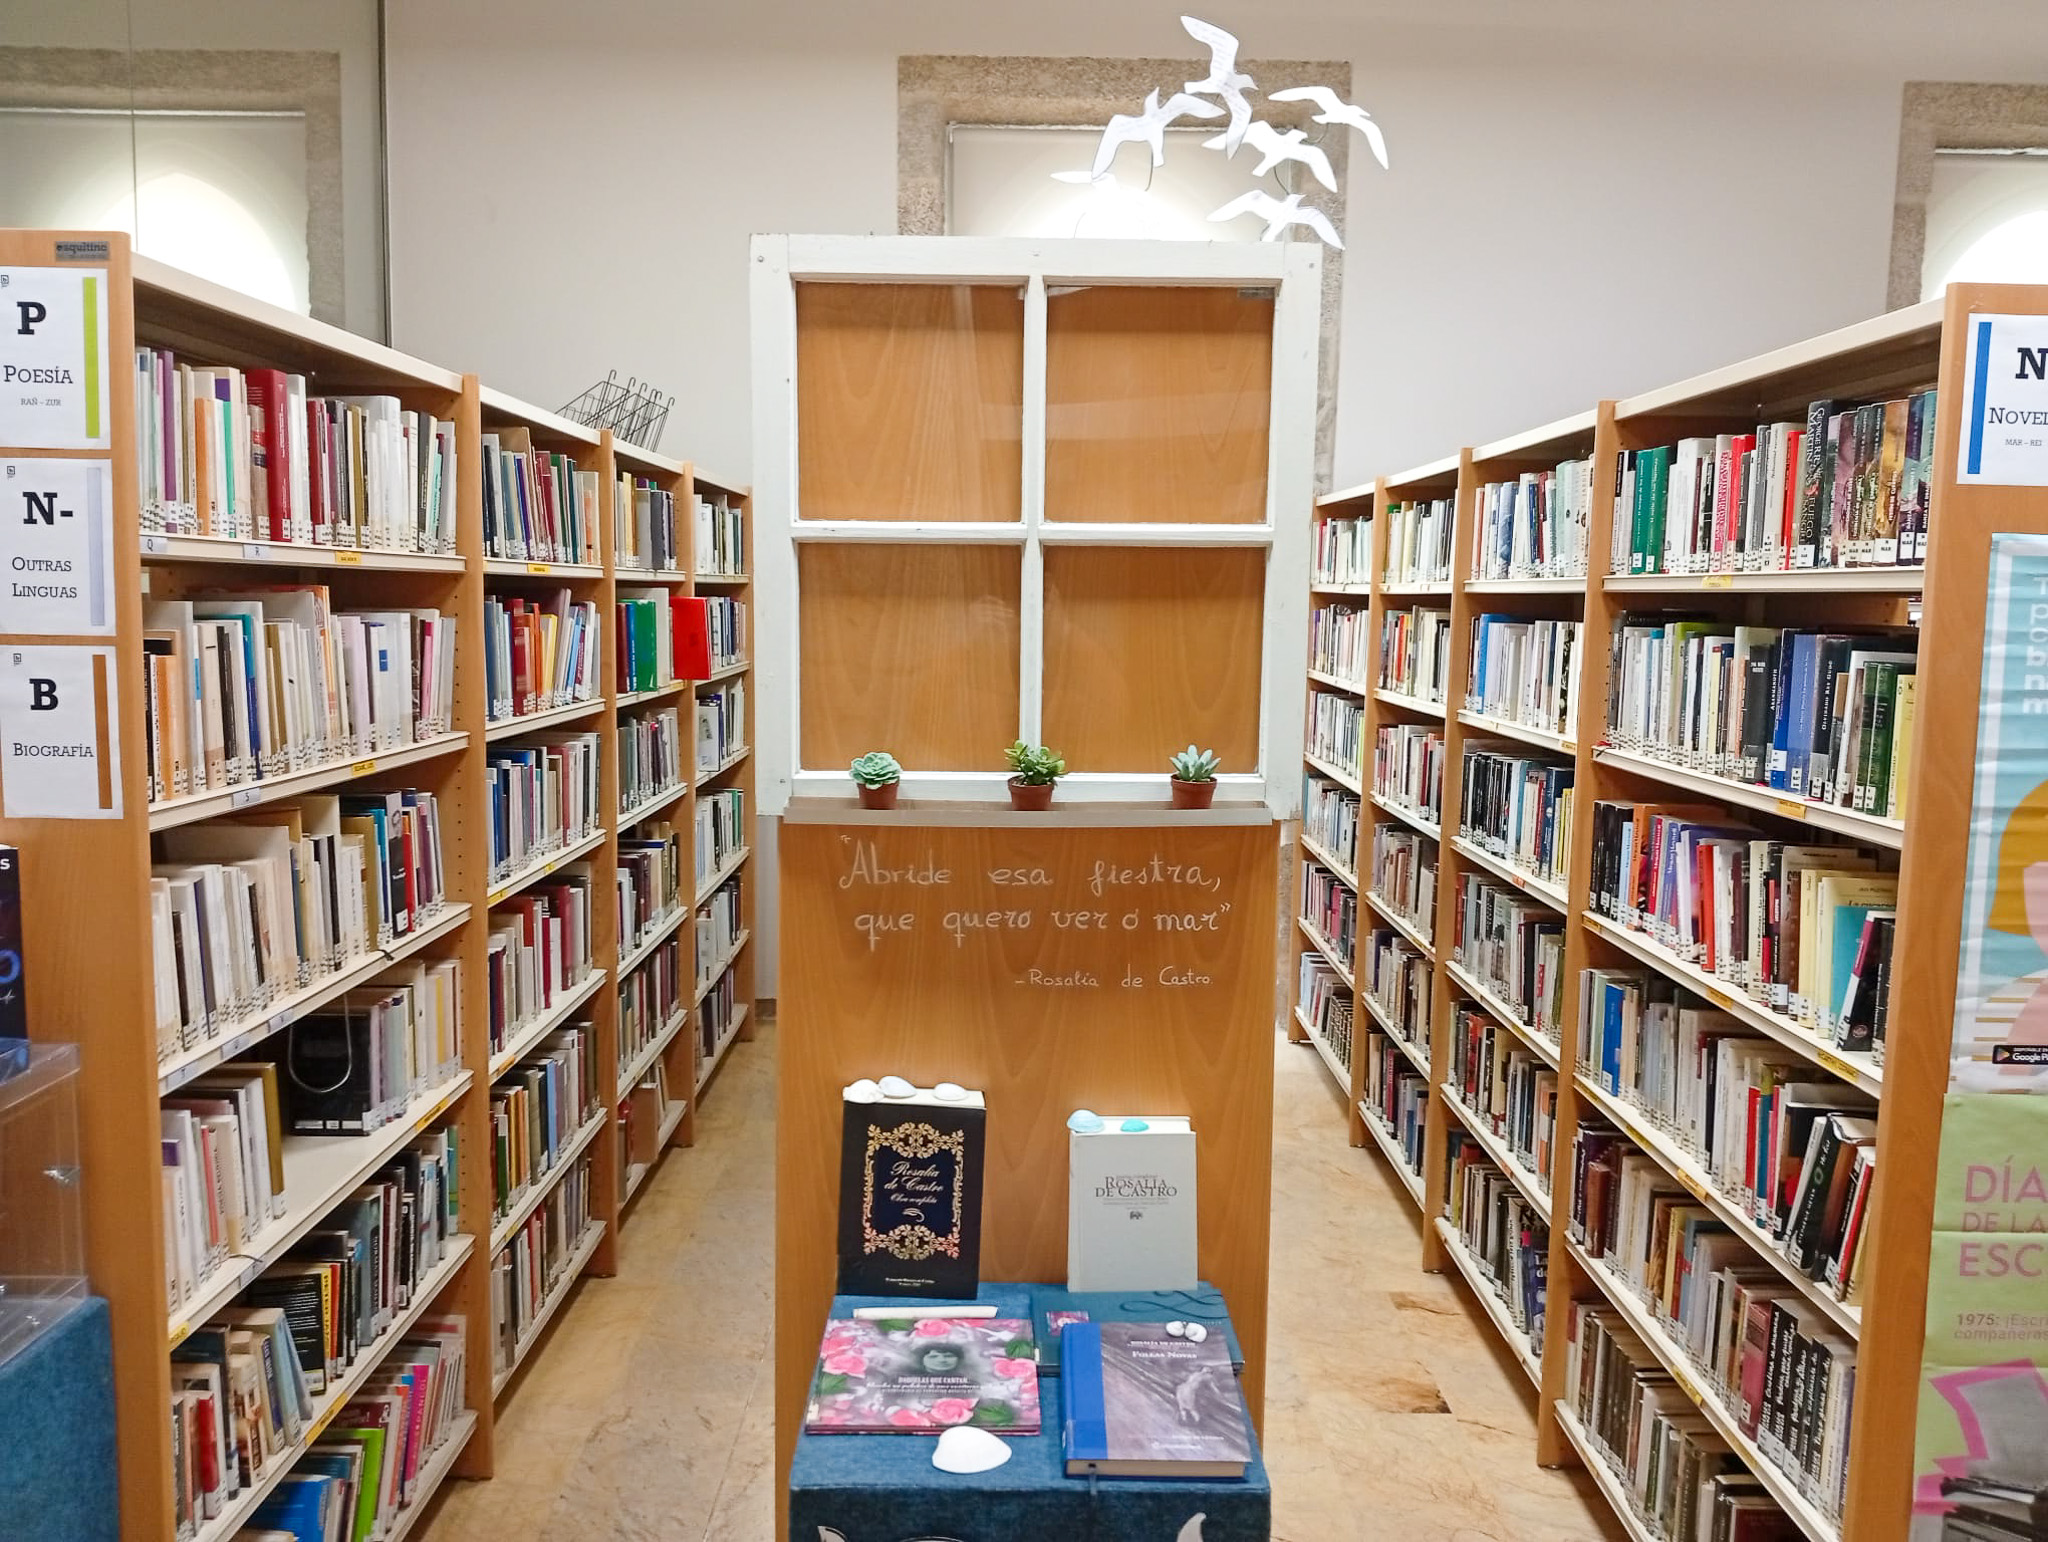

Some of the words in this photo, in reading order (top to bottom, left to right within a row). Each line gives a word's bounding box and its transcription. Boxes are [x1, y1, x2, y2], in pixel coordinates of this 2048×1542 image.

[17, 301, 47, 335] P
[2015, 347, 2048, 380] N
[22, 491, 74, 525] N-
[11, 556, 73, 573] OUTRAS
[11, 582, 78, 599] LINGUAS
[28, 678, 60, 711] B
[12, 742, 95, 758] BIOGRAFÍA
[987, 866, 1054, 886] esa
[854, 909, 915, 953] que
[942, 908, 1031, 949] quero
[1050, 909, 1109, 931] ver
[1121, 963, 1144, 988] de
[2012, 1052, 2041, 1063] Google
[1095, 1187, 1114, 1198] DE
[1118, 1186, 1178, 1198] CASTRO
[1961, 1212, 2000, 1233] DE
